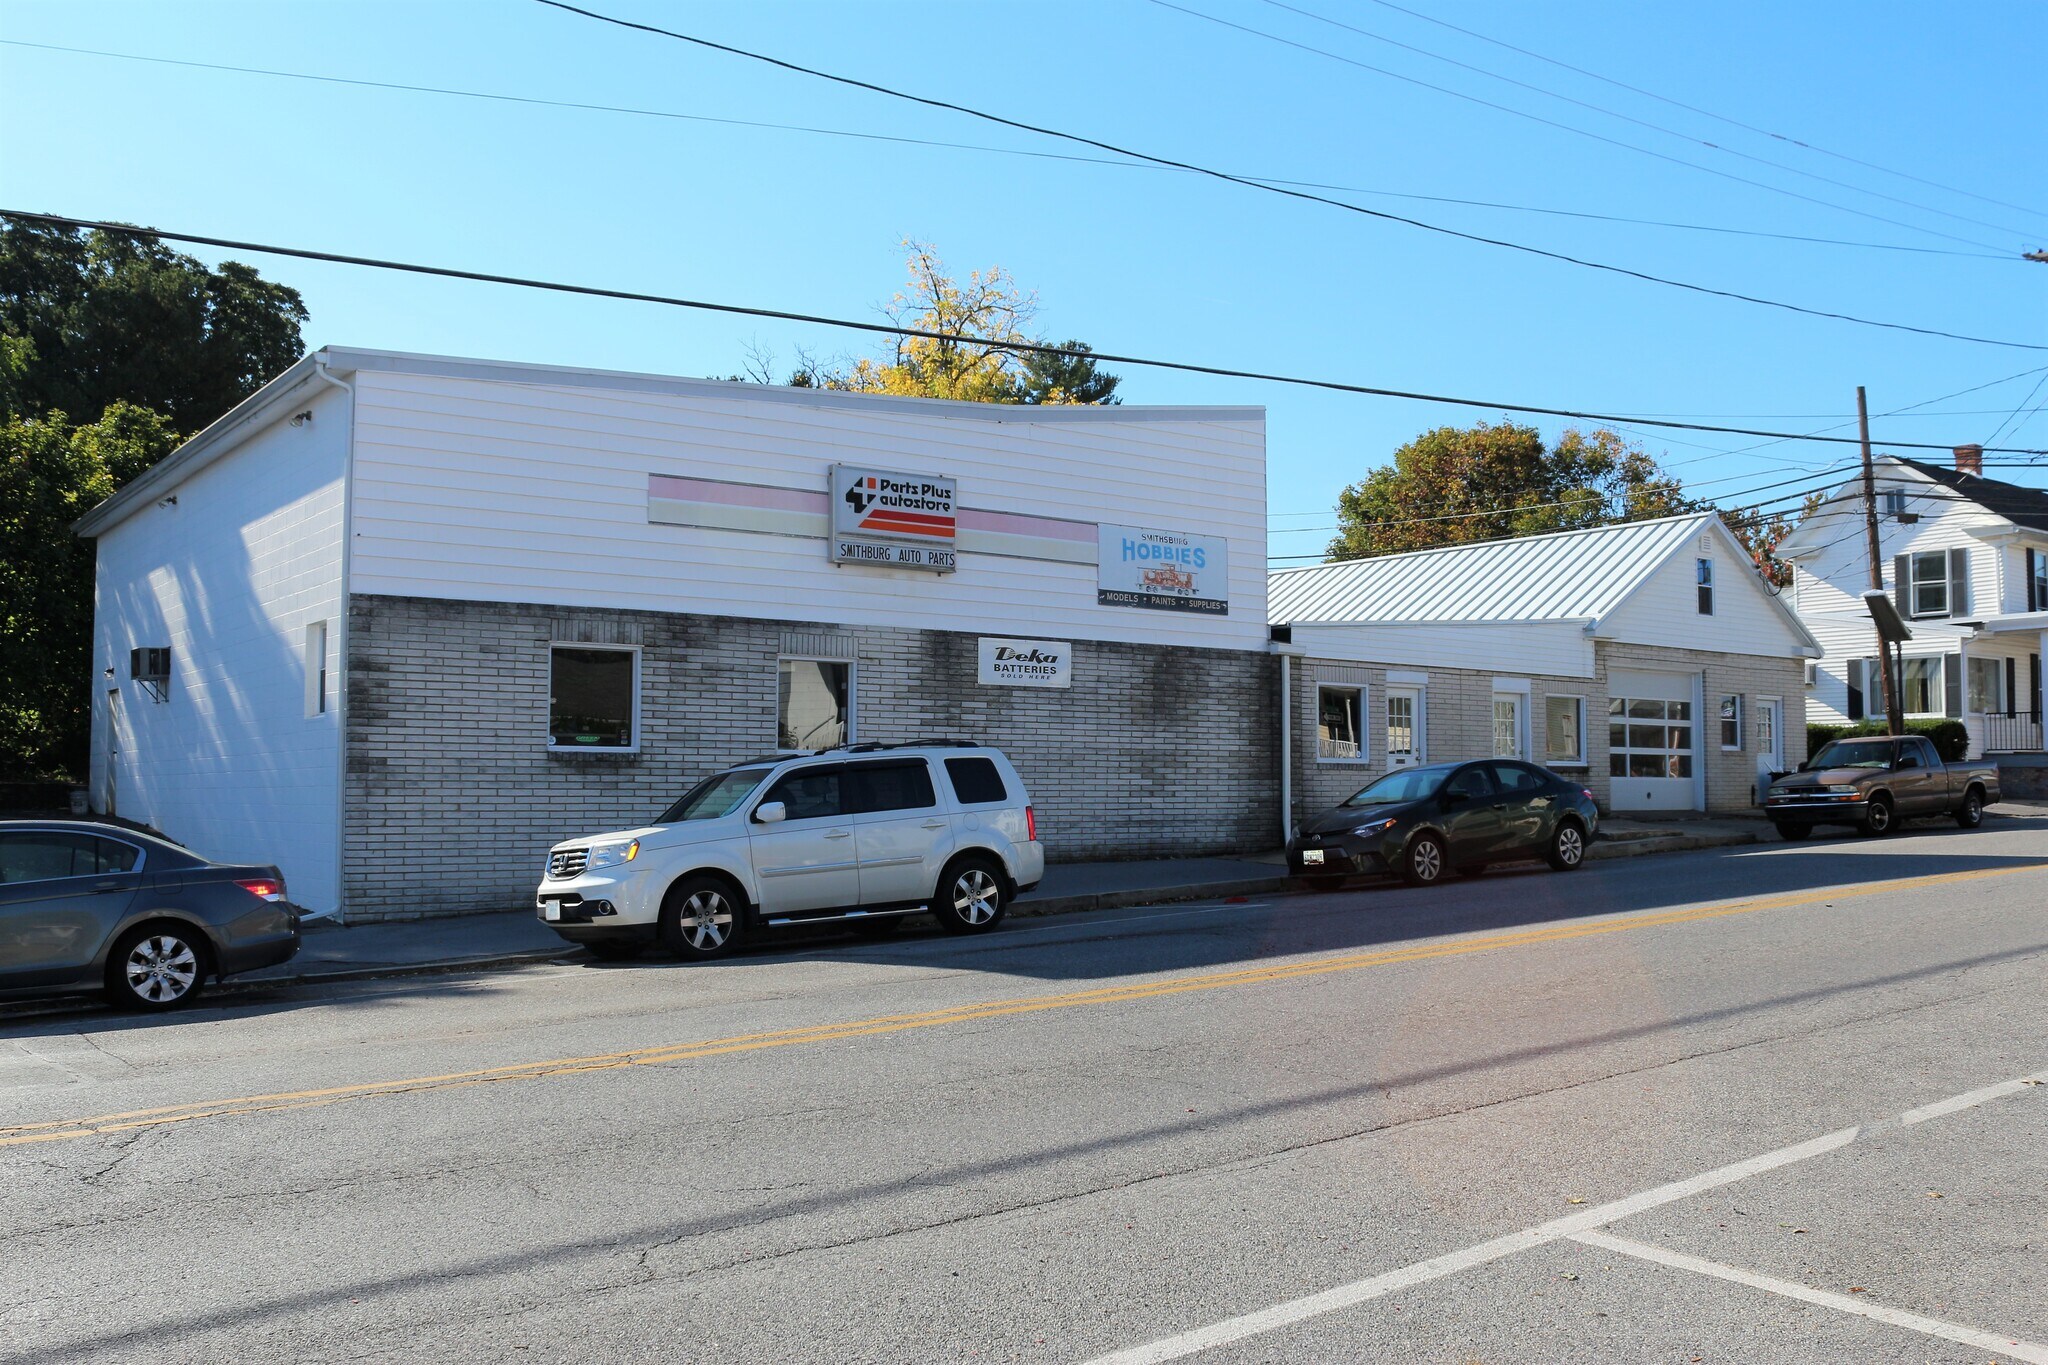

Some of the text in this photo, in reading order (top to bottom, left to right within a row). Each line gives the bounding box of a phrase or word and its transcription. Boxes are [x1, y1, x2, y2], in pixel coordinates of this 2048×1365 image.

[880, 479, 952, 499] Parts Plus
[880, 495, 950, 512] autostore
[1141, 534, 1188, 545] SMITHSBURG
[841, 544, 955, 566] SMITHBURG AUTO PARTS
[1122, 538, 1206, 568] HOBBIES
[1106, 593, 1221, 610] MODELS PAINTS SUPPLIES
[995, 647, 1059, 664] Deka
[994, 664, 1056, 674] BATTERIES
